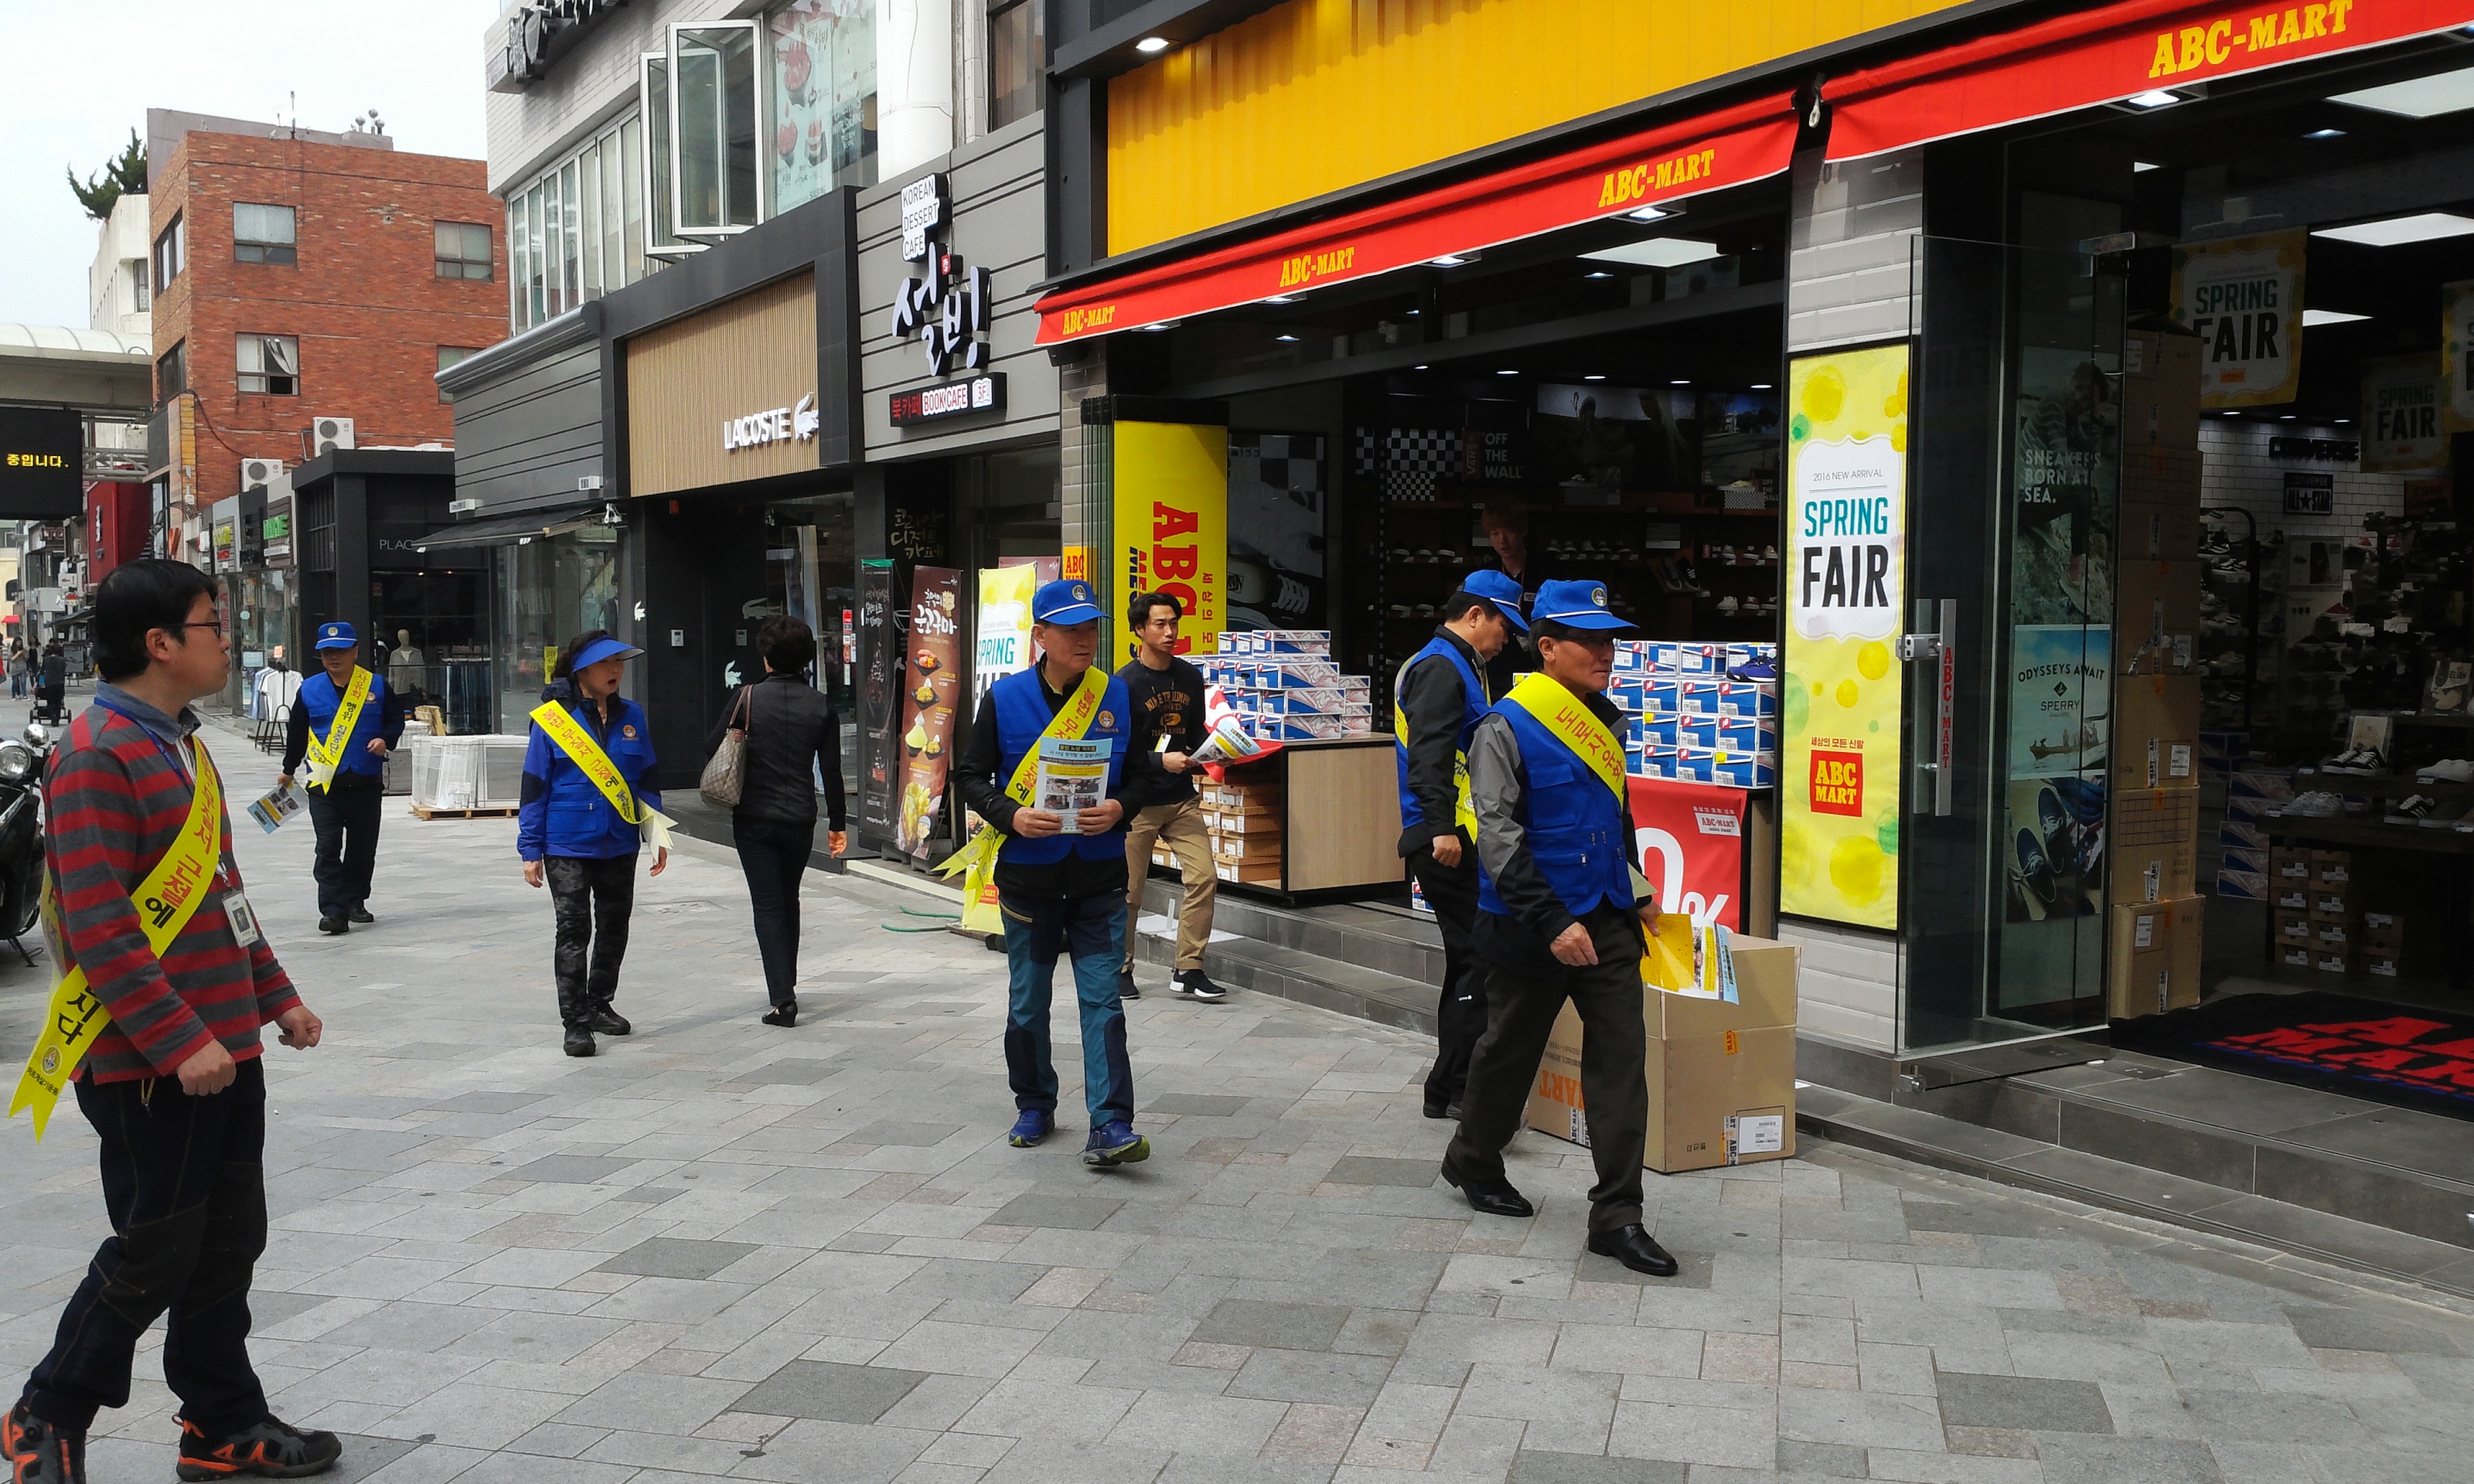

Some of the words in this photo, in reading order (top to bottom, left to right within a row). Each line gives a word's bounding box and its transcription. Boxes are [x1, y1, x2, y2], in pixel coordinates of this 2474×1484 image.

[2148, 0, 2353, 79] ABC-MART
[1597, 148, 1715, 208] ABC-MART
[903, 180, 934, 207] KOREAN
[903, 203, 939, 232] DESSERT
[904, 235, 925, 258] CAFE
[1280, 247, 1355, 288] ABC-MART
[2195, 279, 2278, 315] SPRING
[1062, 305, 1116, 335] ABC-MART
[891, 393, 922, 420] 북카페
[923, 393, 946, 413] BOOK
[946, 388, 967, 409] CAFE
[2378, 384, 2435, 408] SPRING
[724, 407, 792, 450] LACOSTE
[2377, 406, 2436, 441] FAIR
[7, 454, 69, 468] 중입니다.
[1467, 443, 1477, 475] VANS
[1484, 449, 1508, 461] THE
[2025, 449, 2101, 468] SNEAKERS
[1813, 472, 1831, 482] 2016
[1832, 471, 1850, 481] NEW
[1851, 468, 1883, 480] ARRIVAL
[2024, 468, 2067, 485] BORN
[2289, 475, 2329, 486] CONVERSE
[2024, 486, 2057, 504] SEA.
[2288, 489, 2299, 512] ALL
[1804, 497, 1888, 537] SPRING
[891, 529, 938, 546] 디저트
[905, 543, 944, 560] 카페
[1065, 556, 1085, 574] ABC
[1802, 544, 1890, 608] FAIR
[914, 604, 958, 636] 군고구마
[2018, 663, 2071, 682] ODYSSEYS
[2074, 665, 2105, 680] AWAIT
[341, 702, 357, 722] 행위
[1942, 647, 1953, 768] ABC-MART
[2040, 700, 2080, 711] SPERRY
[1554, 705, 1624, 783] 도로사유화
[1811, 737, 1830, 748] 세상의
[1832, 738, 1847, 749] 모든
[1849, 739, 1864, 750] 신발
[590, 758, 619, 788] 근절에
[1815, 760, 1857, 787] ABC
[1815, 785, 1857, 805] MART
[1701, 817, 1736, 828] ABC-MART
[145, 854, 203, 930] 근절에
[58, 985, 102, 1046] 시다
